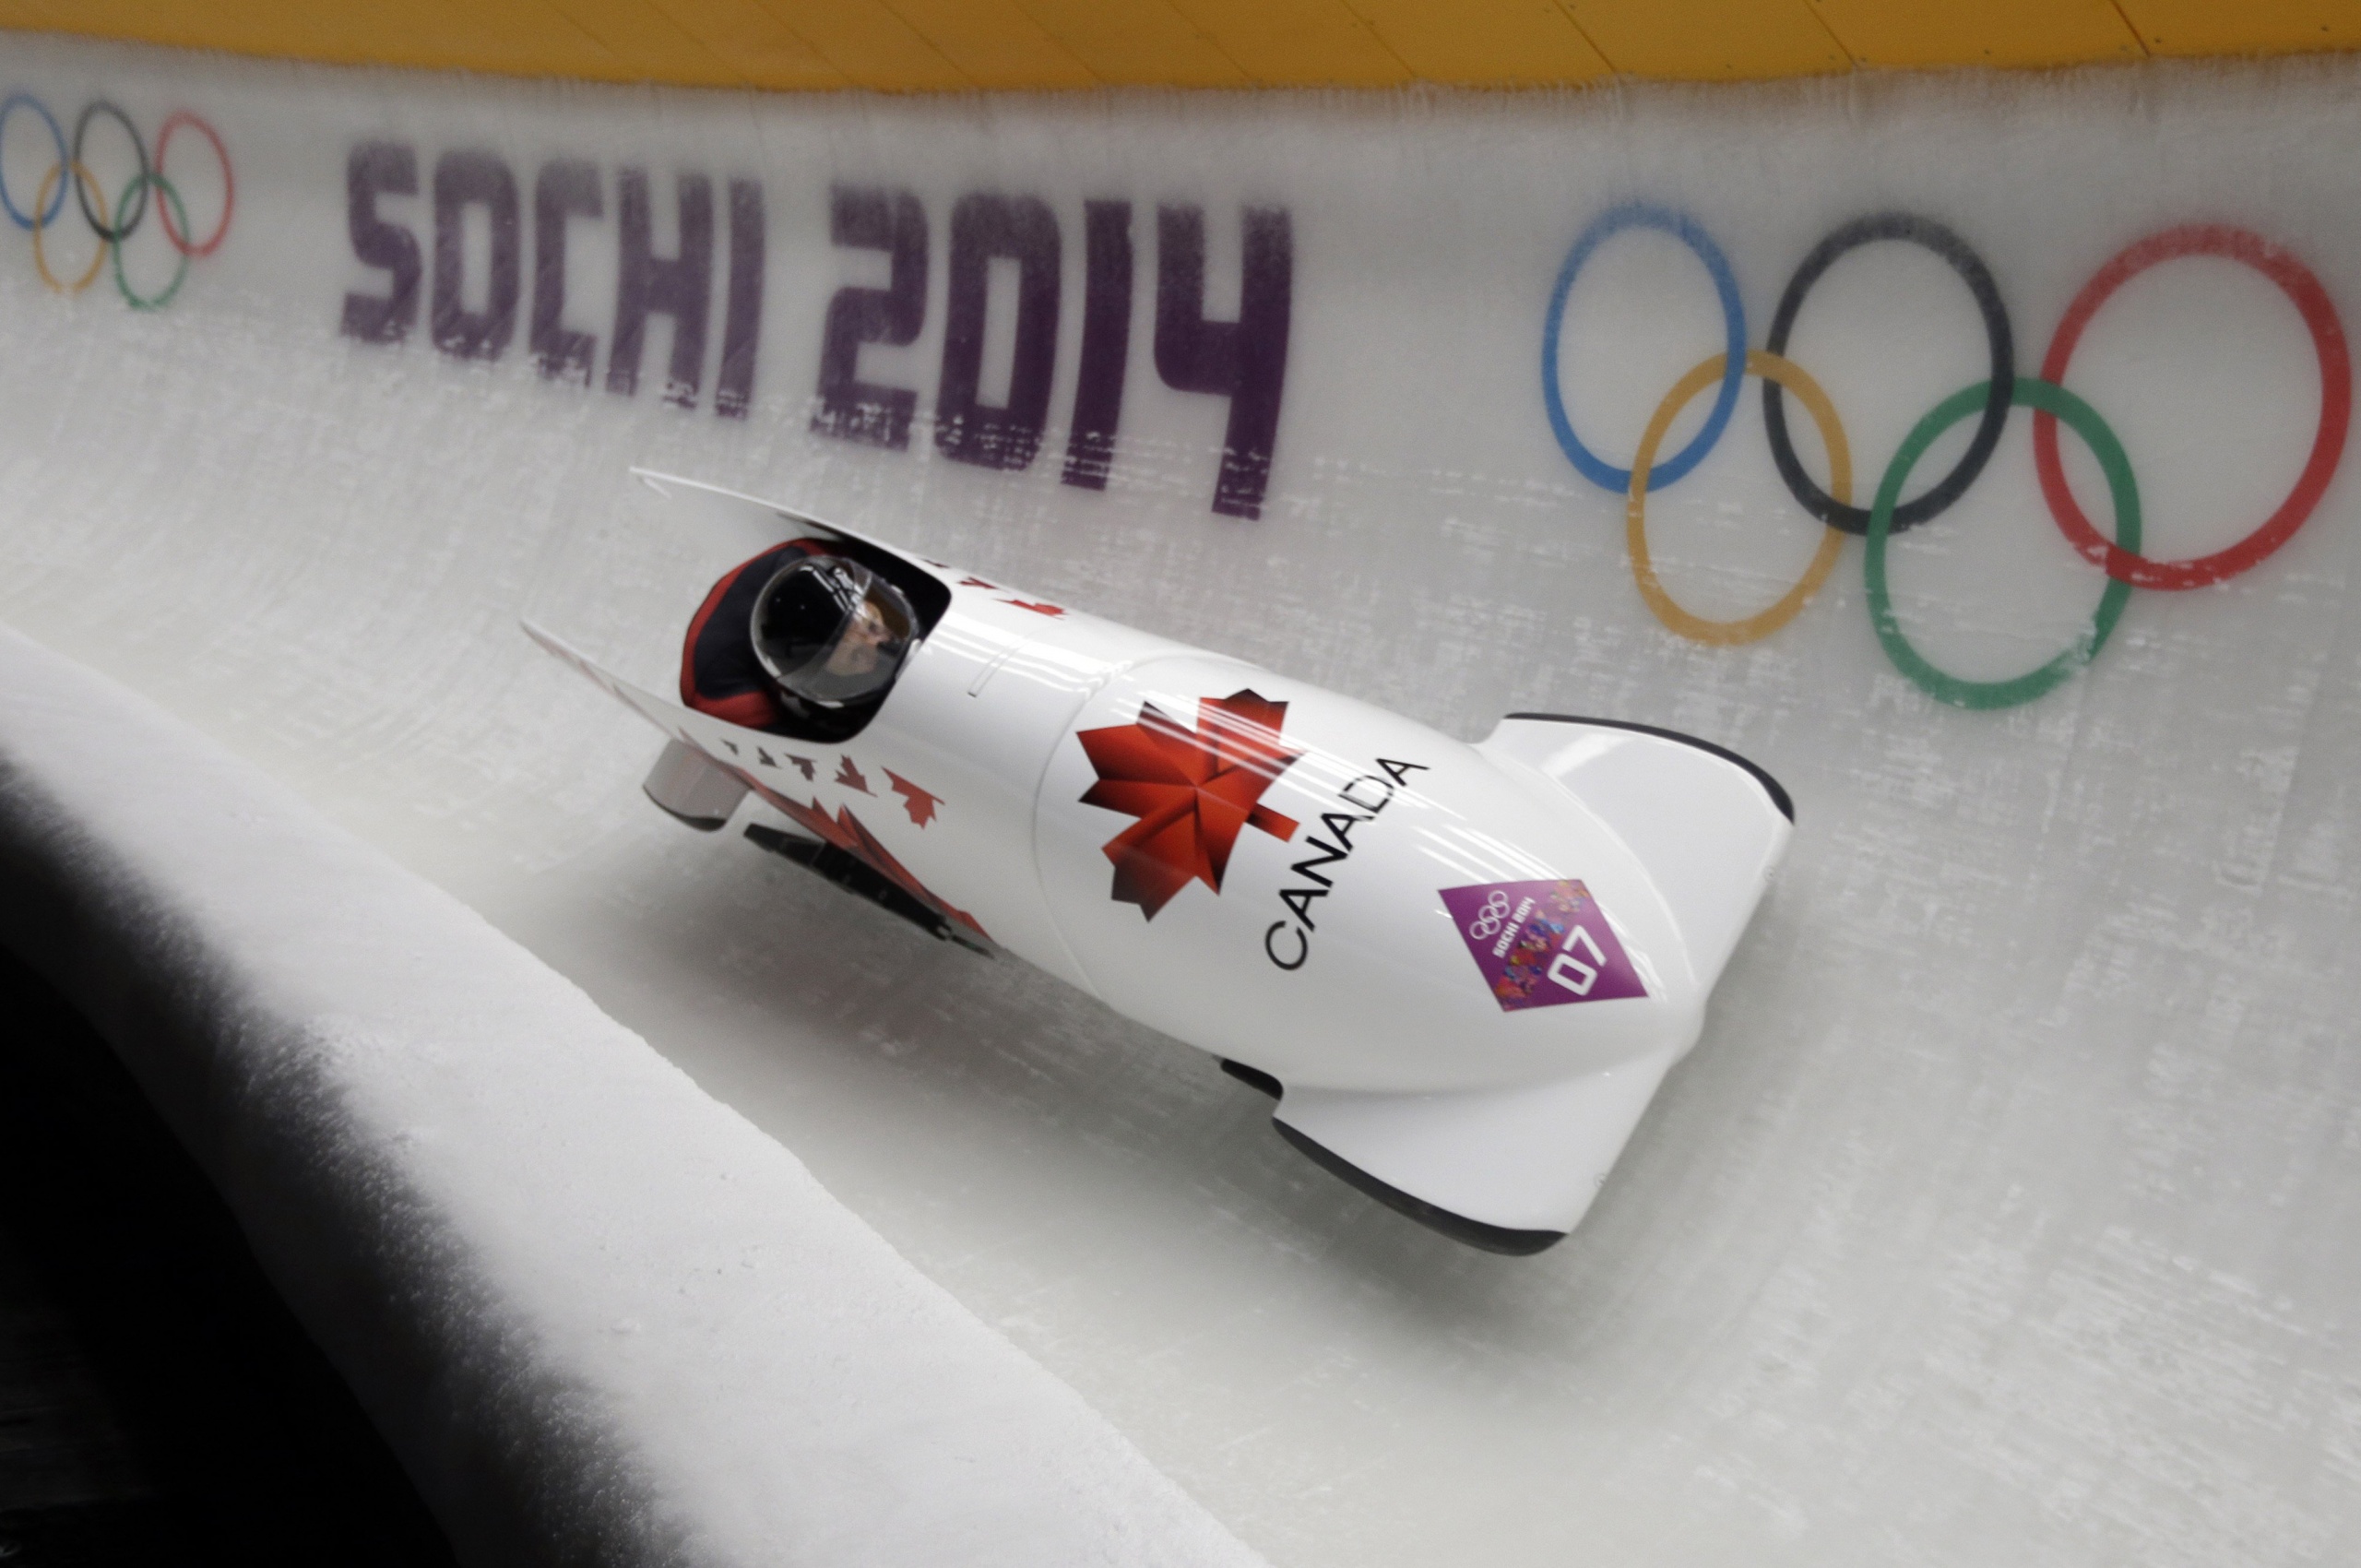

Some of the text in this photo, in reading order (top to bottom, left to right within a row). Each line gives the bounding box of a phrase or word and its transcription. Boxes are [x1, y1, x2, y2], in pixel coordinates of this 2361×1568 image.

[340, 141, 1293, 520] SOCHI 2014
[1264, 758, 1430, 970] CANADA
[1492, 896, 1536, 958] SOCHI 2014
[1547, 924, 1607, 996] 07
